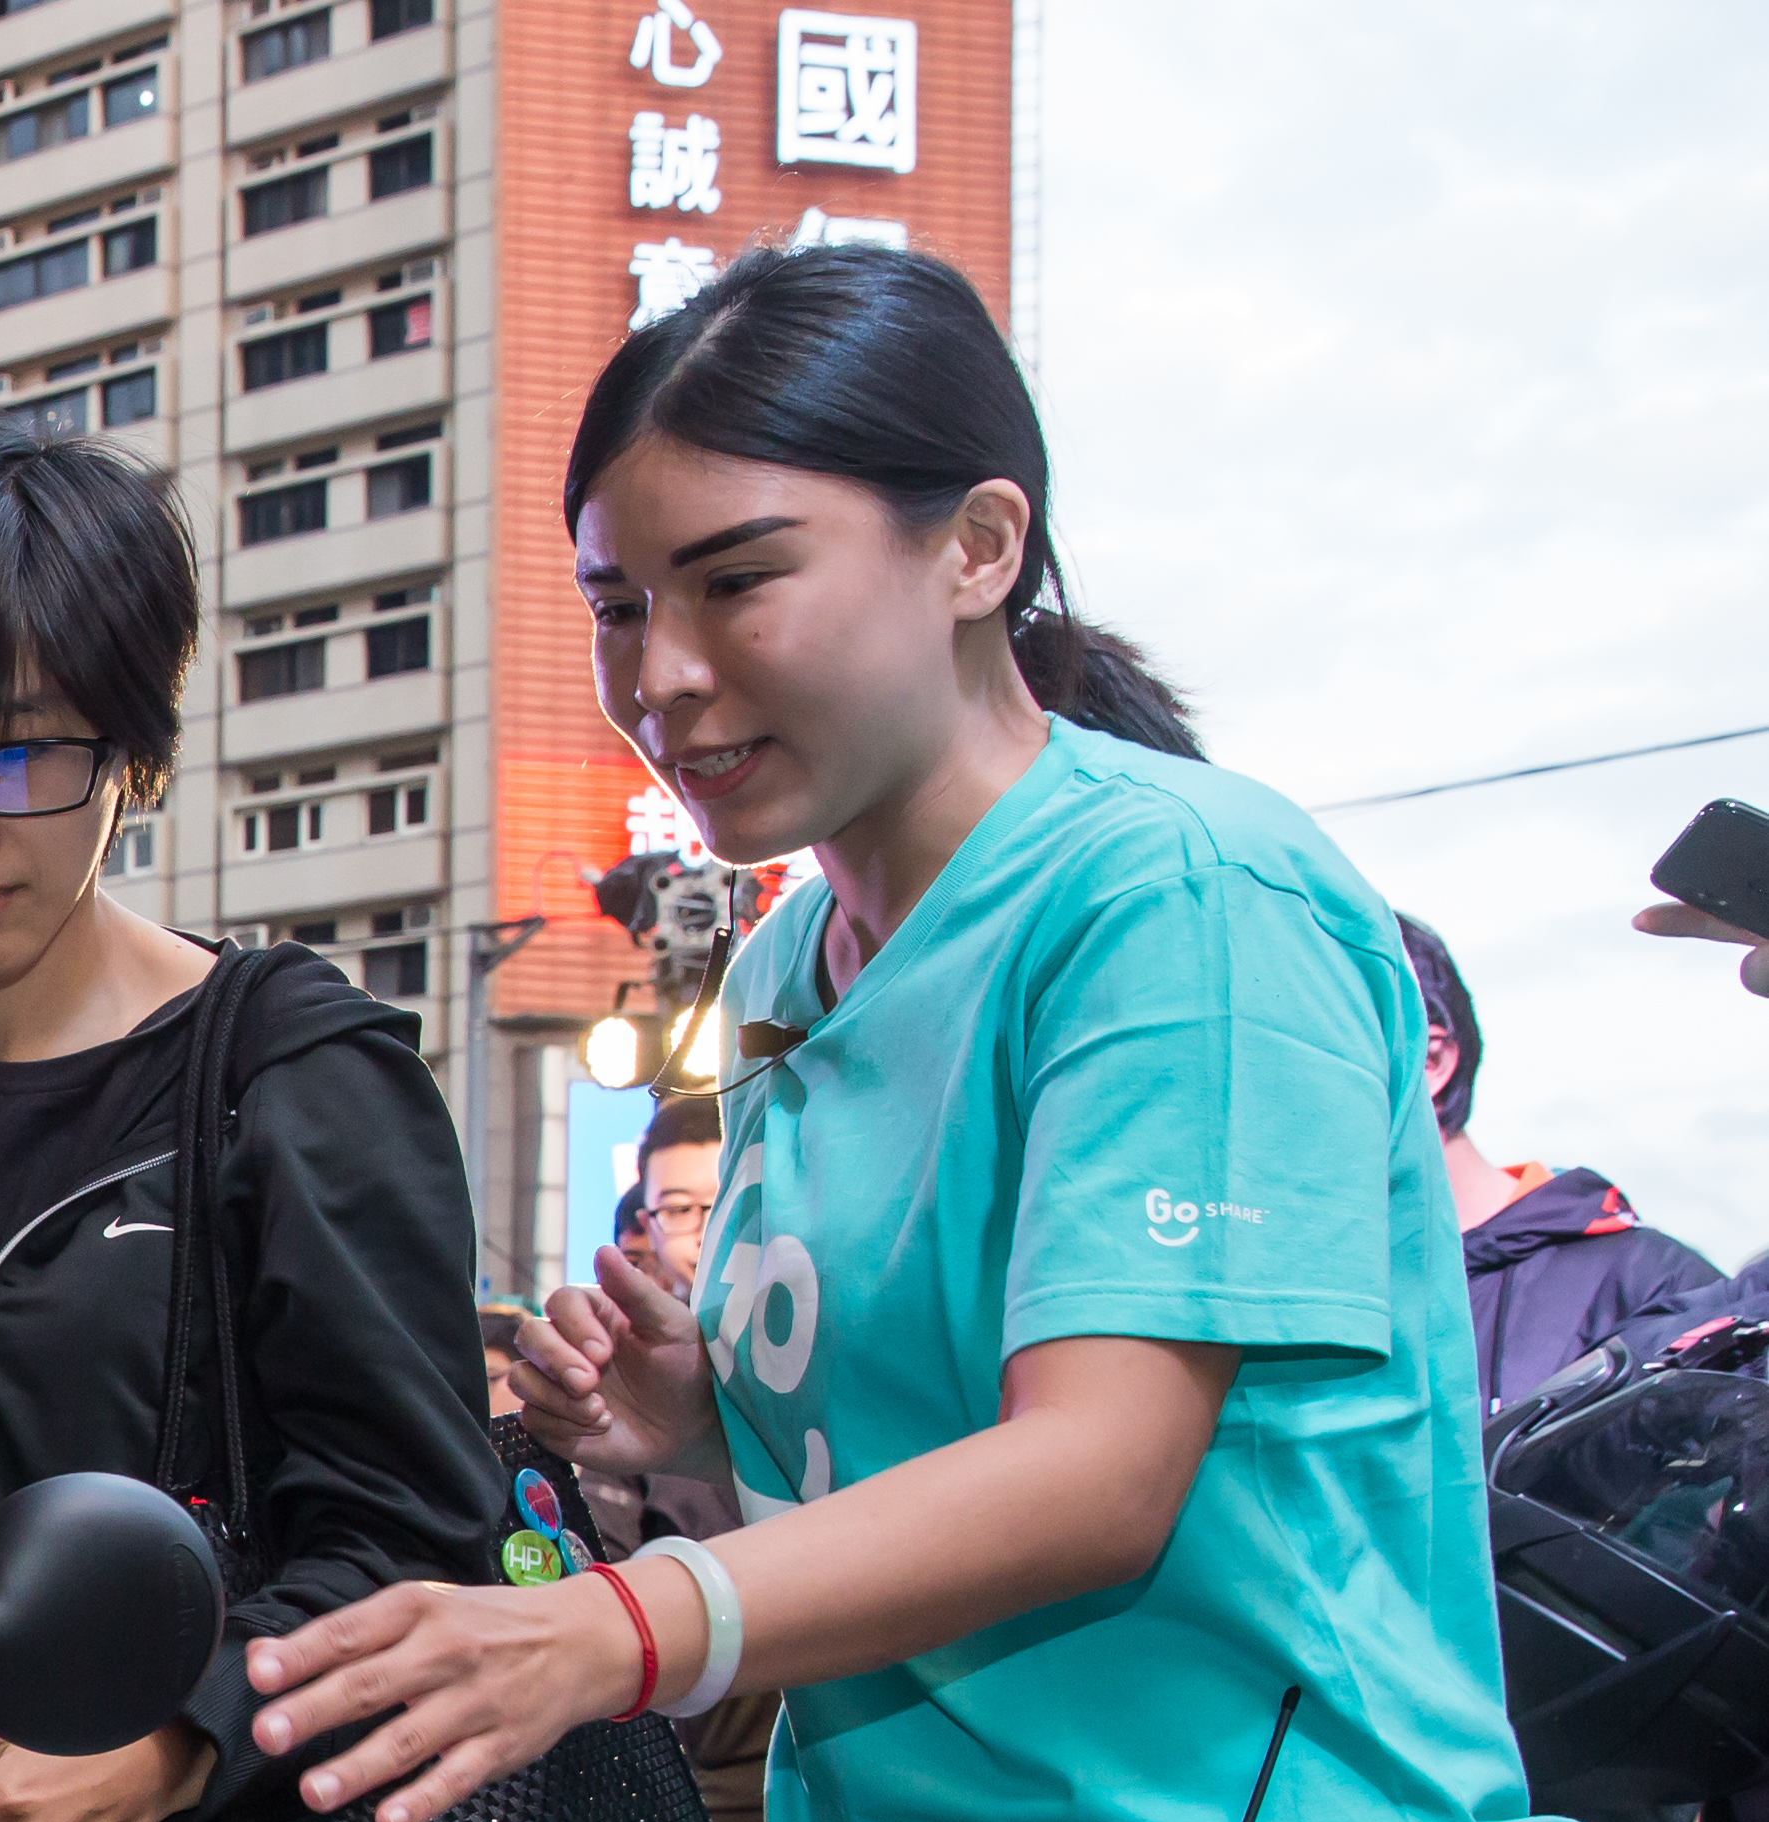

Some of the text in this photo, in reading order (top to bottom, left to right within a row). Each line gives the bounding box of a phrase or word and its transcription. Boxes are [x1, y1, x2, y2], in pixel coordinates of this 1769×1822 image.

[1145, 1188, 1264, 1225] Go SHARE
[509, 1542, 554, 1576] HPX
